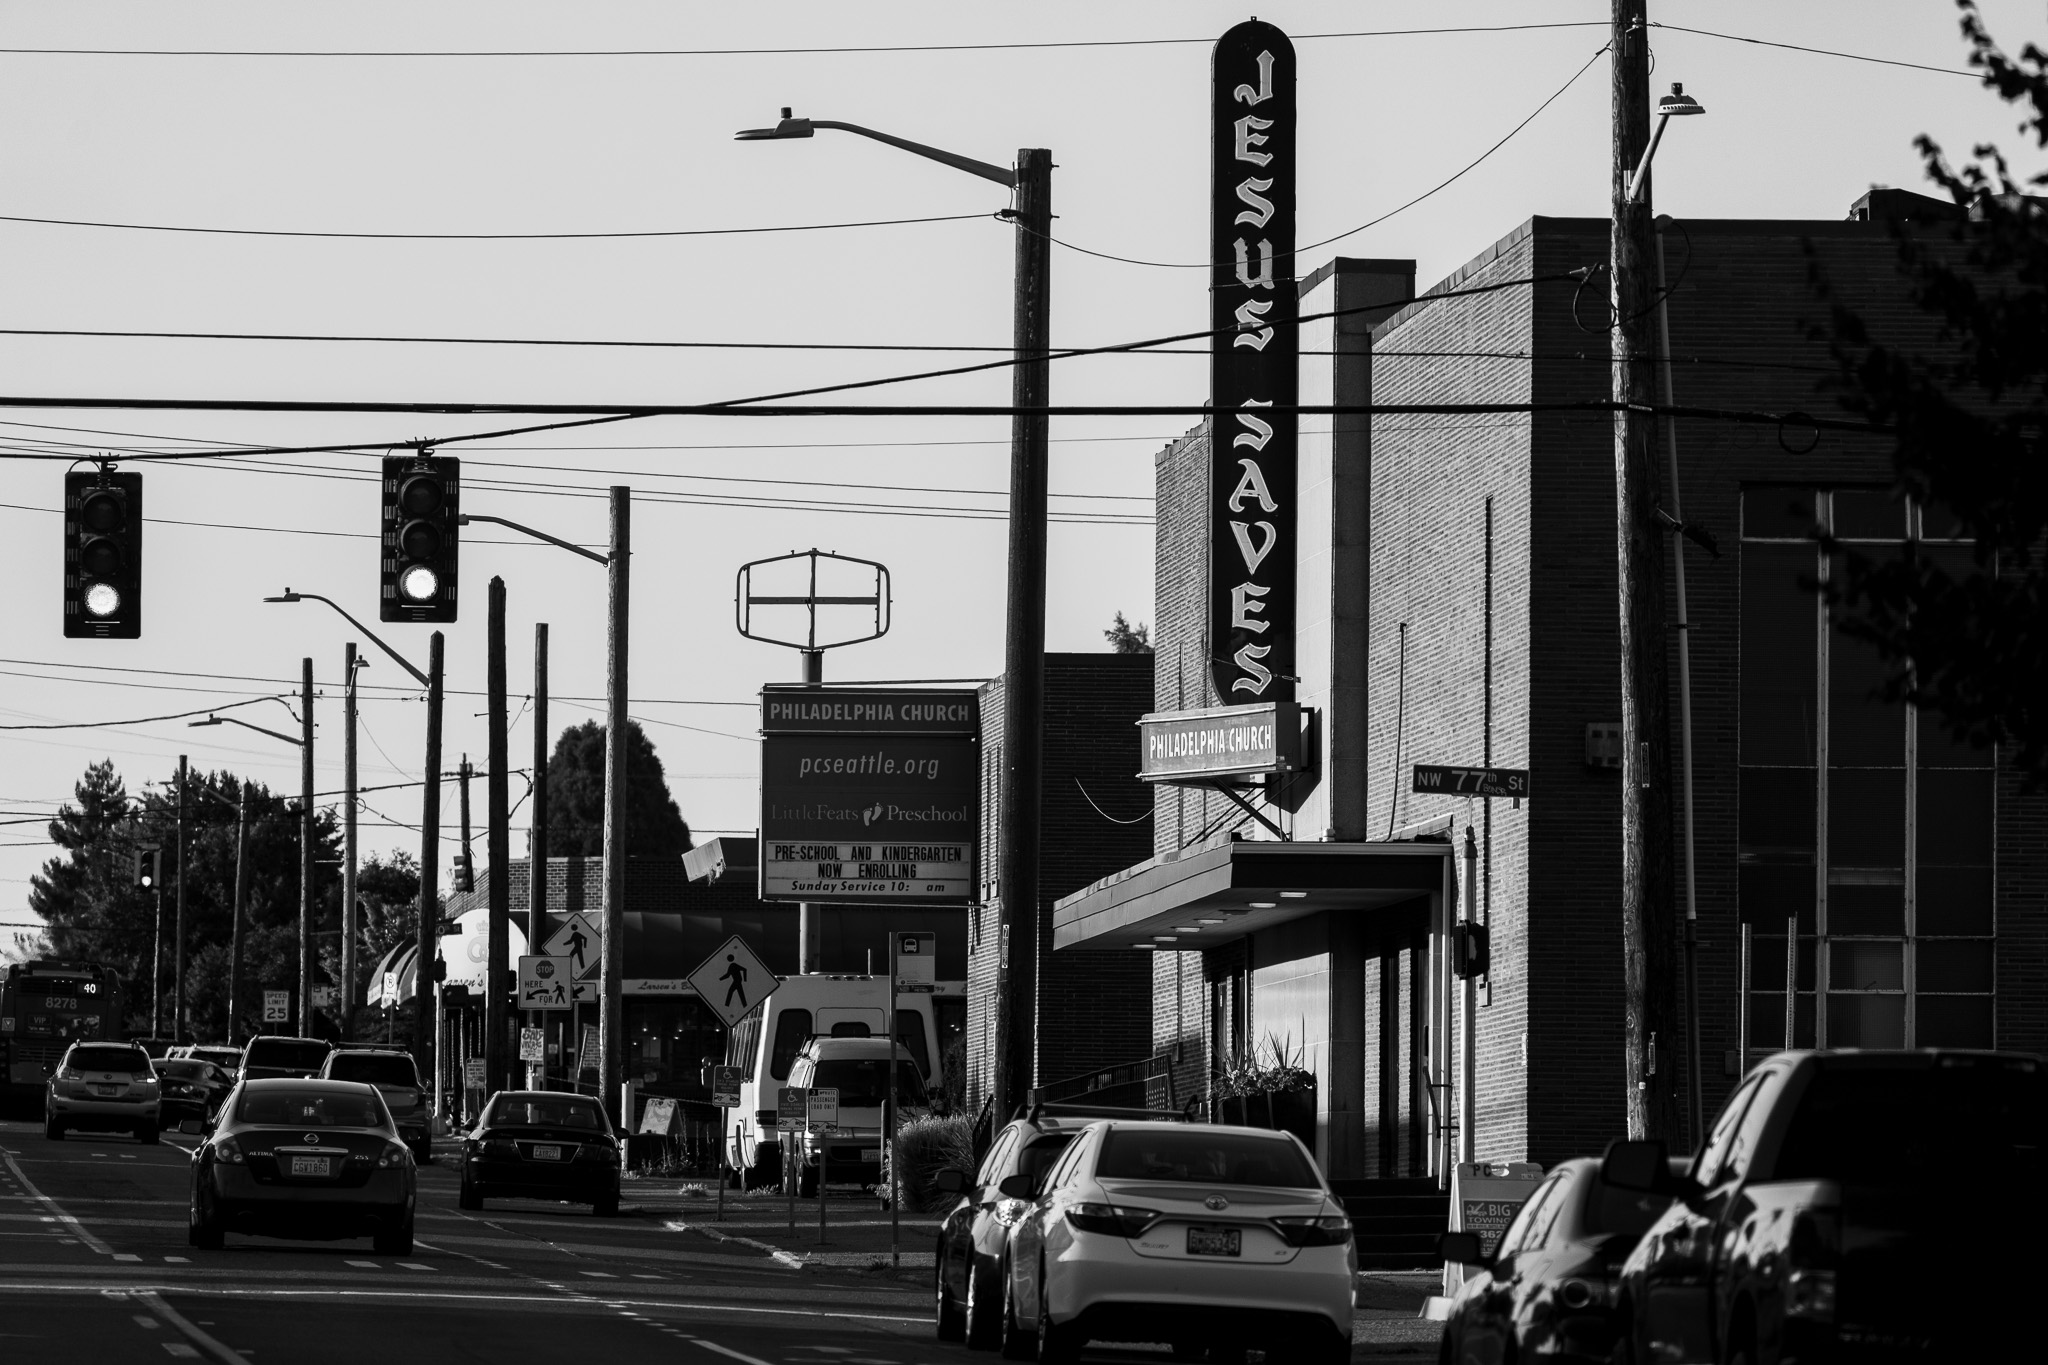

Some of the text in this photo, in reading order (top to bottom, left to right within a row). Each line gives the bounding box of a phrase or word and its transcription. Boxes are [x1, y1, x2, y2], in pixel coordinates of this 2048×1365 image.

[1229, 49, 1278, 696] JESUS SAVES
[770, 703, 969, 722] PHILADELPHIA CHURCH
[1150, 725, 1272, 759] PHILADELPHIA CHURCH
[800, 752, 939, 779] pcseattle.org
[1418, 772, 1442, 786] NW
[1508, 776, 1524, 790] St
[888, 805, 967, 822] Preschool
[775, 845, 961, 862] PRE-SCHOOL AND KINDERGARTEN
[818, 864, 917, 878] NOW ENROLLING
[792, 881, 837, 893] Sunday
[841, 881, 885, 892] Service
[926, 883, 945, 892] am
[84, 983, 96, 994] 40
[637, 981, 677, 990] Larsen's
[46, 997, 77, 1009] 8278
[539, 995, 553, 1003] FOR
[267, 1008, 286, 1019] 25
[1489, 1204, 1511, 1216] BIG
